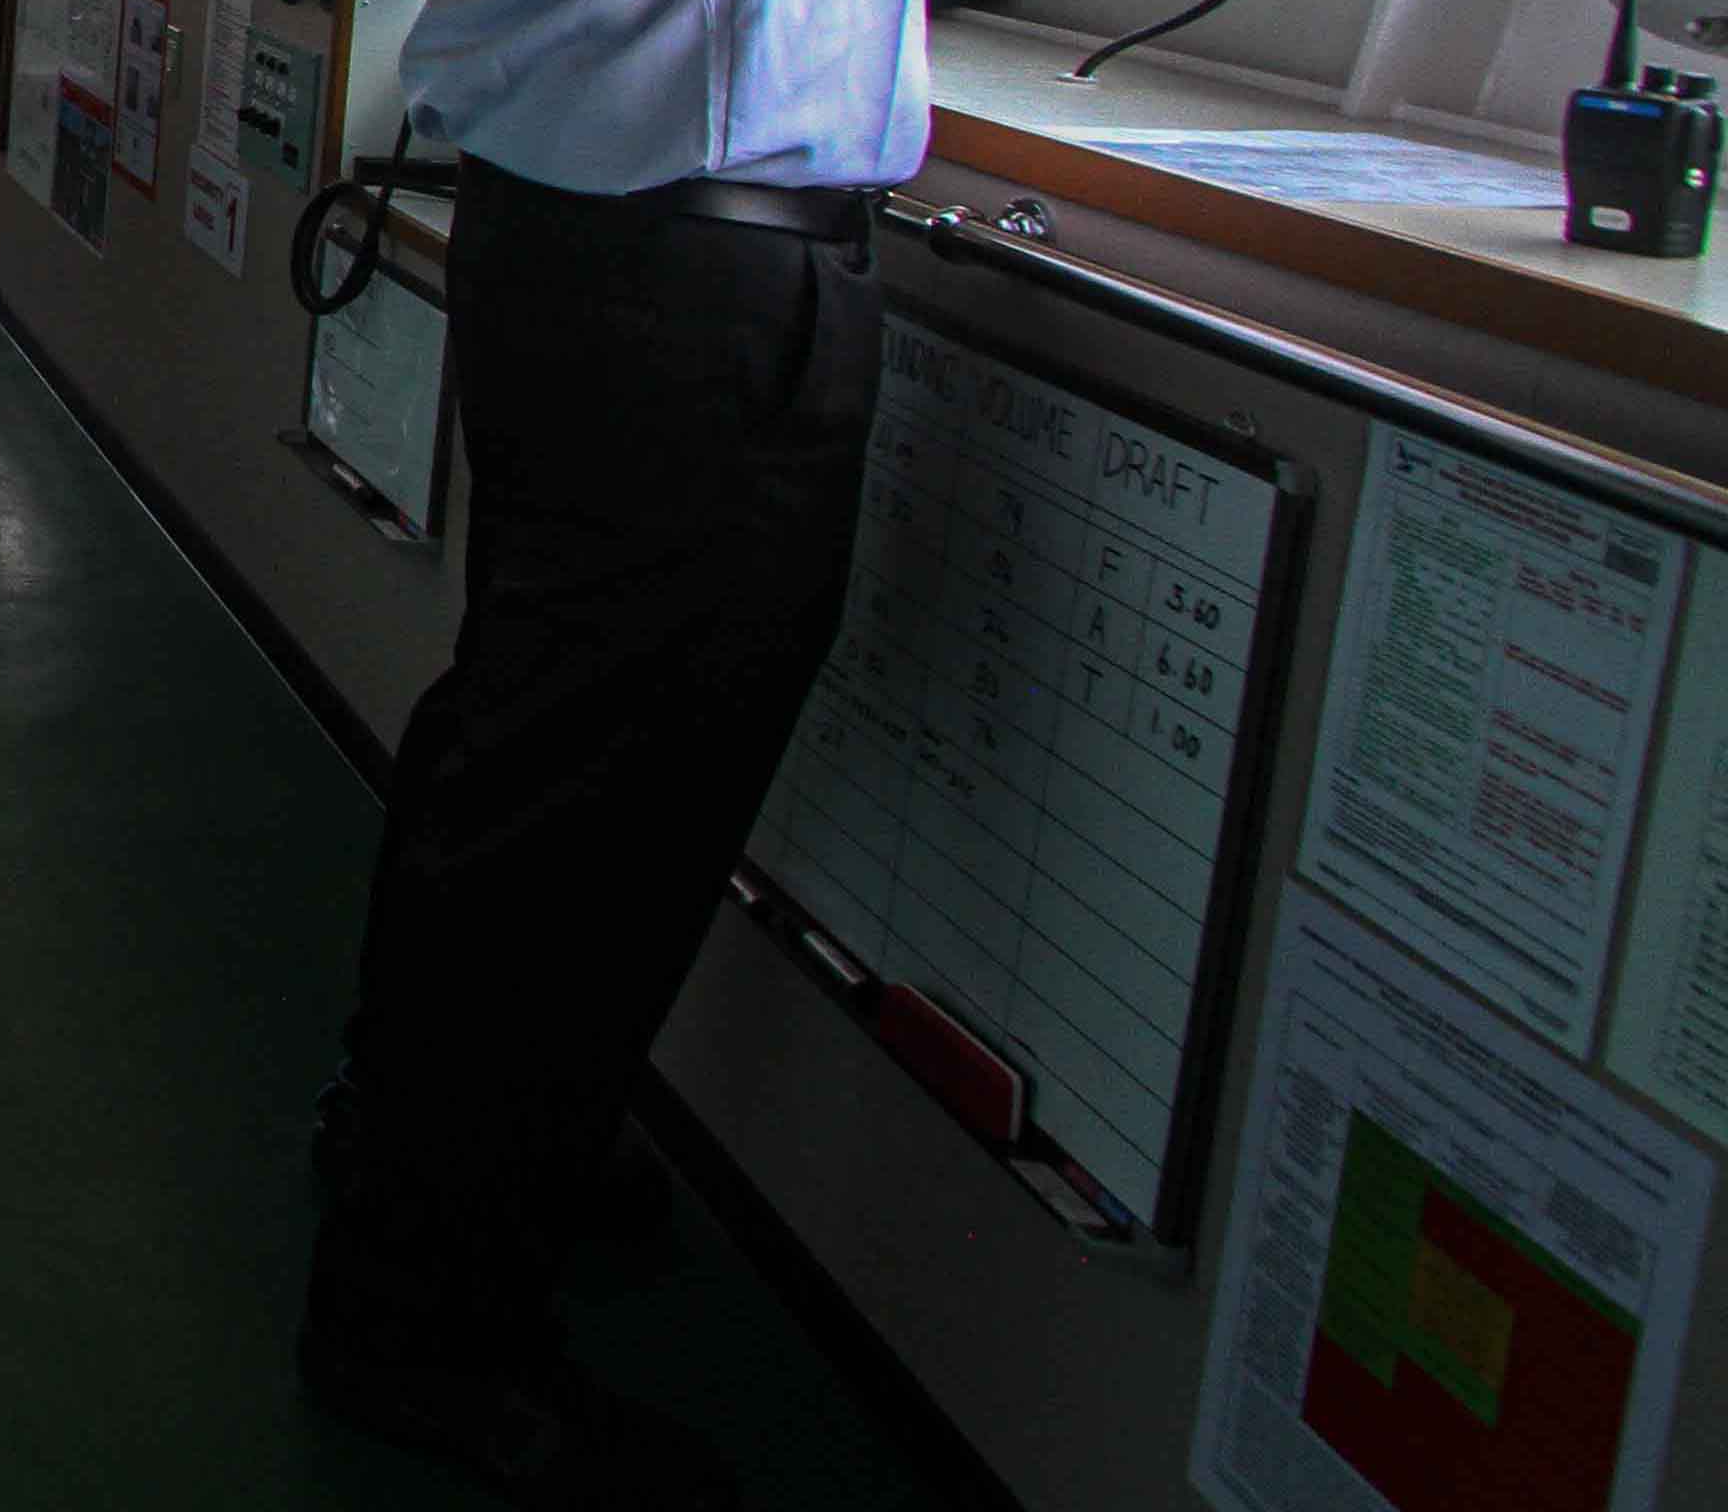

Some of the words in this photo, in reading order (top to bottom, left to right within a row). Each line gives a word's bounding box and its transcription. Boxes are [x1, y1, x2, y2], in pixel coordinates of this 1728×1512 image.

[1102, 432, 1222, 525] DRAFT
[1088, 607, 1105, 645] A
[1082, 663, 1103, 703] T
